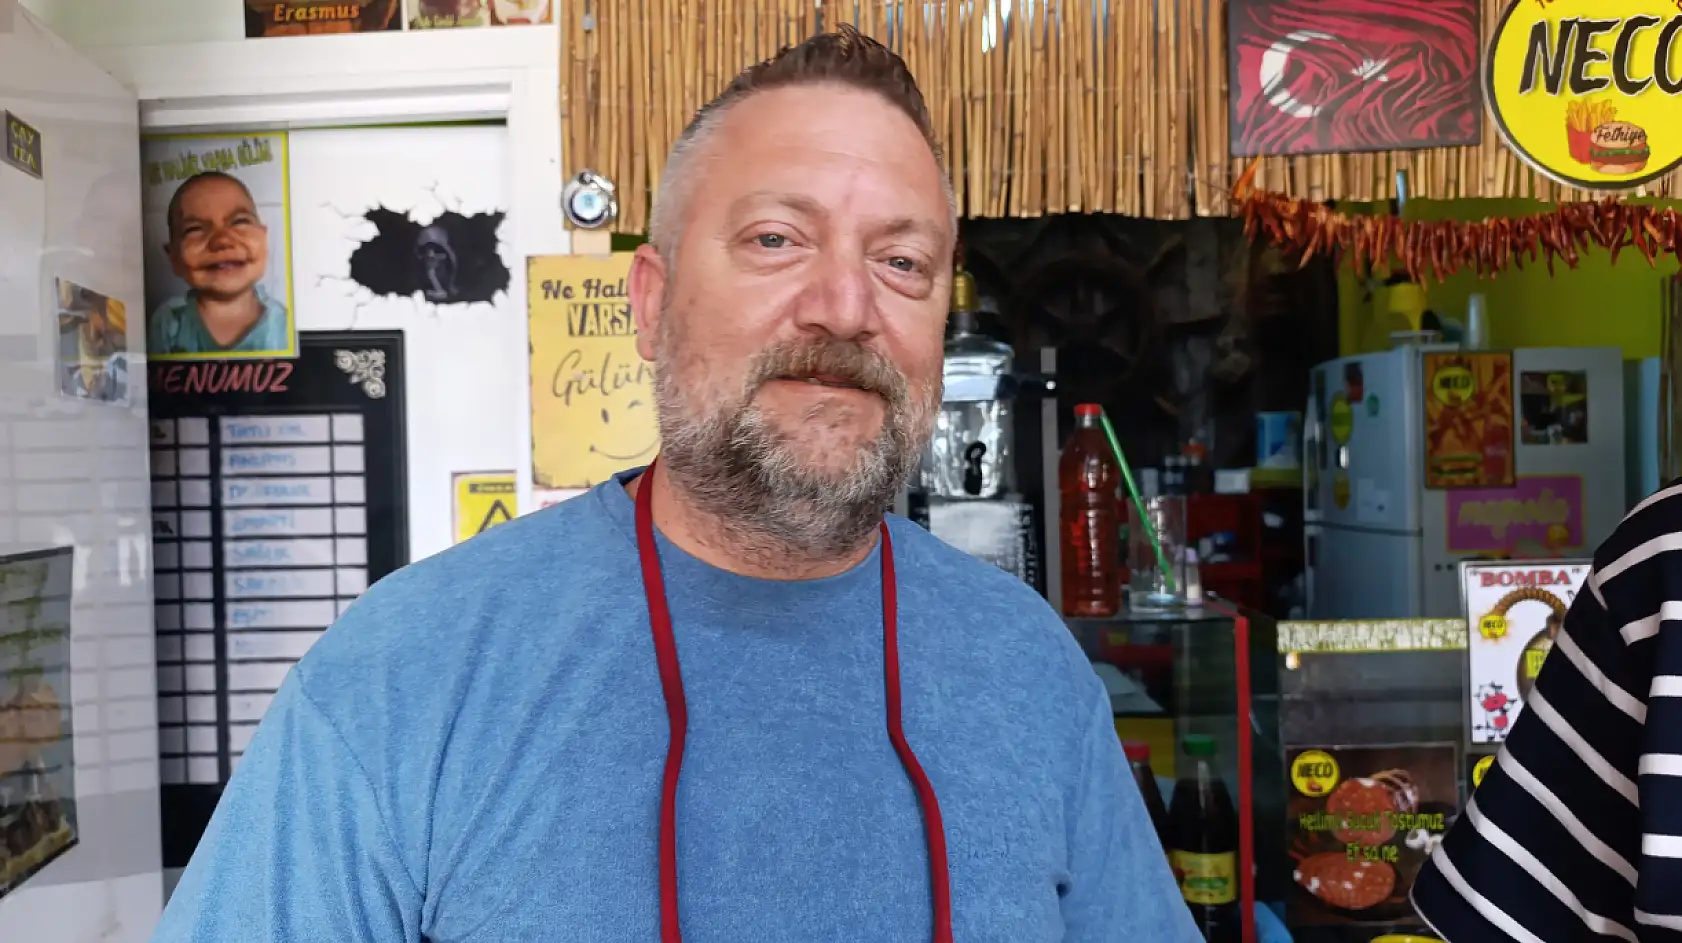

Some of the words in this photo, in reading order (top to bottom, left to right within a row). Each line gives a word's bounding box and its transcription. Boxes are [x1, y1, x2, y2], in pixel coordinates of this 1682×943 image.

[274, 3, 360, 22] Erasmus
[542, 278, 576, 300] Ne
[583, 277, 629, 298] Hal
[567, 302, 637, 337] VARS
[1297, 762, 1333, 778] NECO
